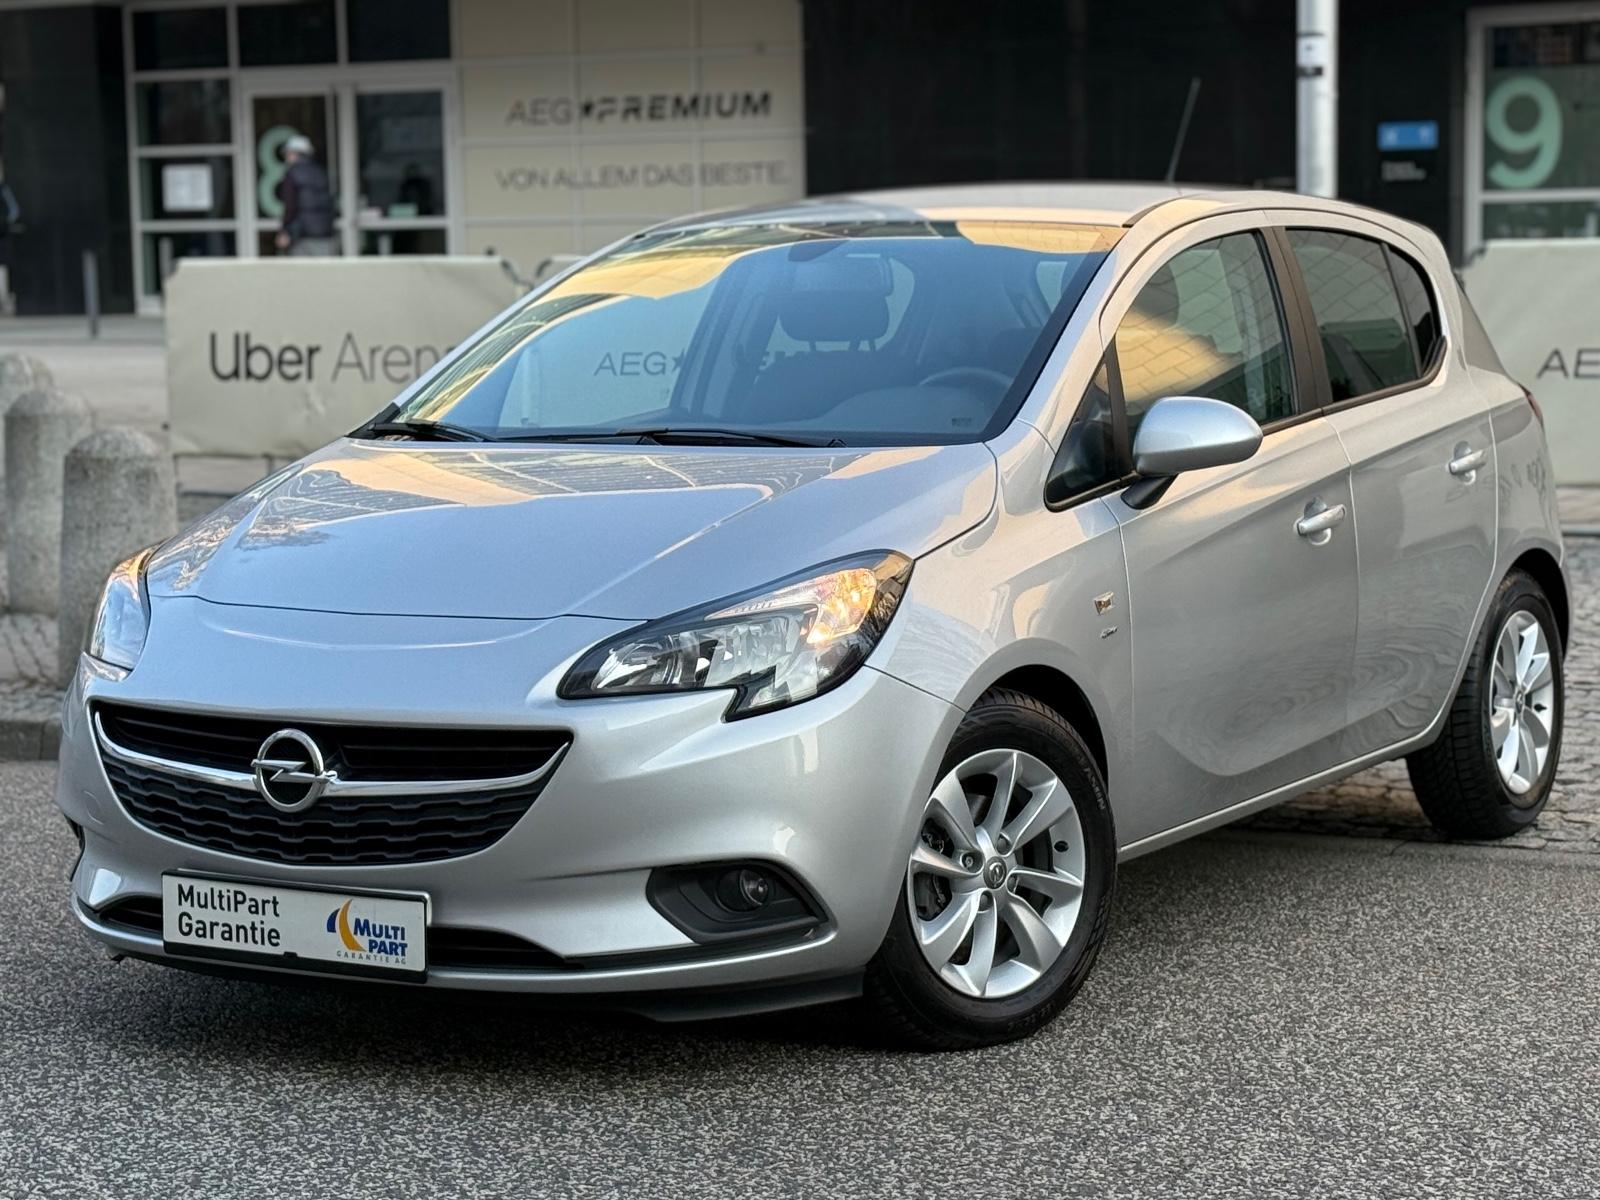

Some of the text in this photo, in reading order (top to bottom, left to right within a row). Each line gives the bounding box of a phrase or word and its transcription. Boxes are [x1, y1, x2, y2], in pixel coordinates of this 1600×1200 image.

[506, 91, 771, 126] AEG PREMIUM
[1486, 75, 1564, 190] 9
[494, 166, 546, 191] VON
[550, 163, 639, 190] ALLEM
[210, 331, 456, 384] Uber Aren
[593, 351, 667, 377] AEG
[177, 883, 280, 918] MultiPart
[178, 911, 281, 948] Garantie
[353, 917, 406, 941] MULTI
[336, 950, 407, 965] GARANTIE AG
[368, 938, 408, 957] PART
